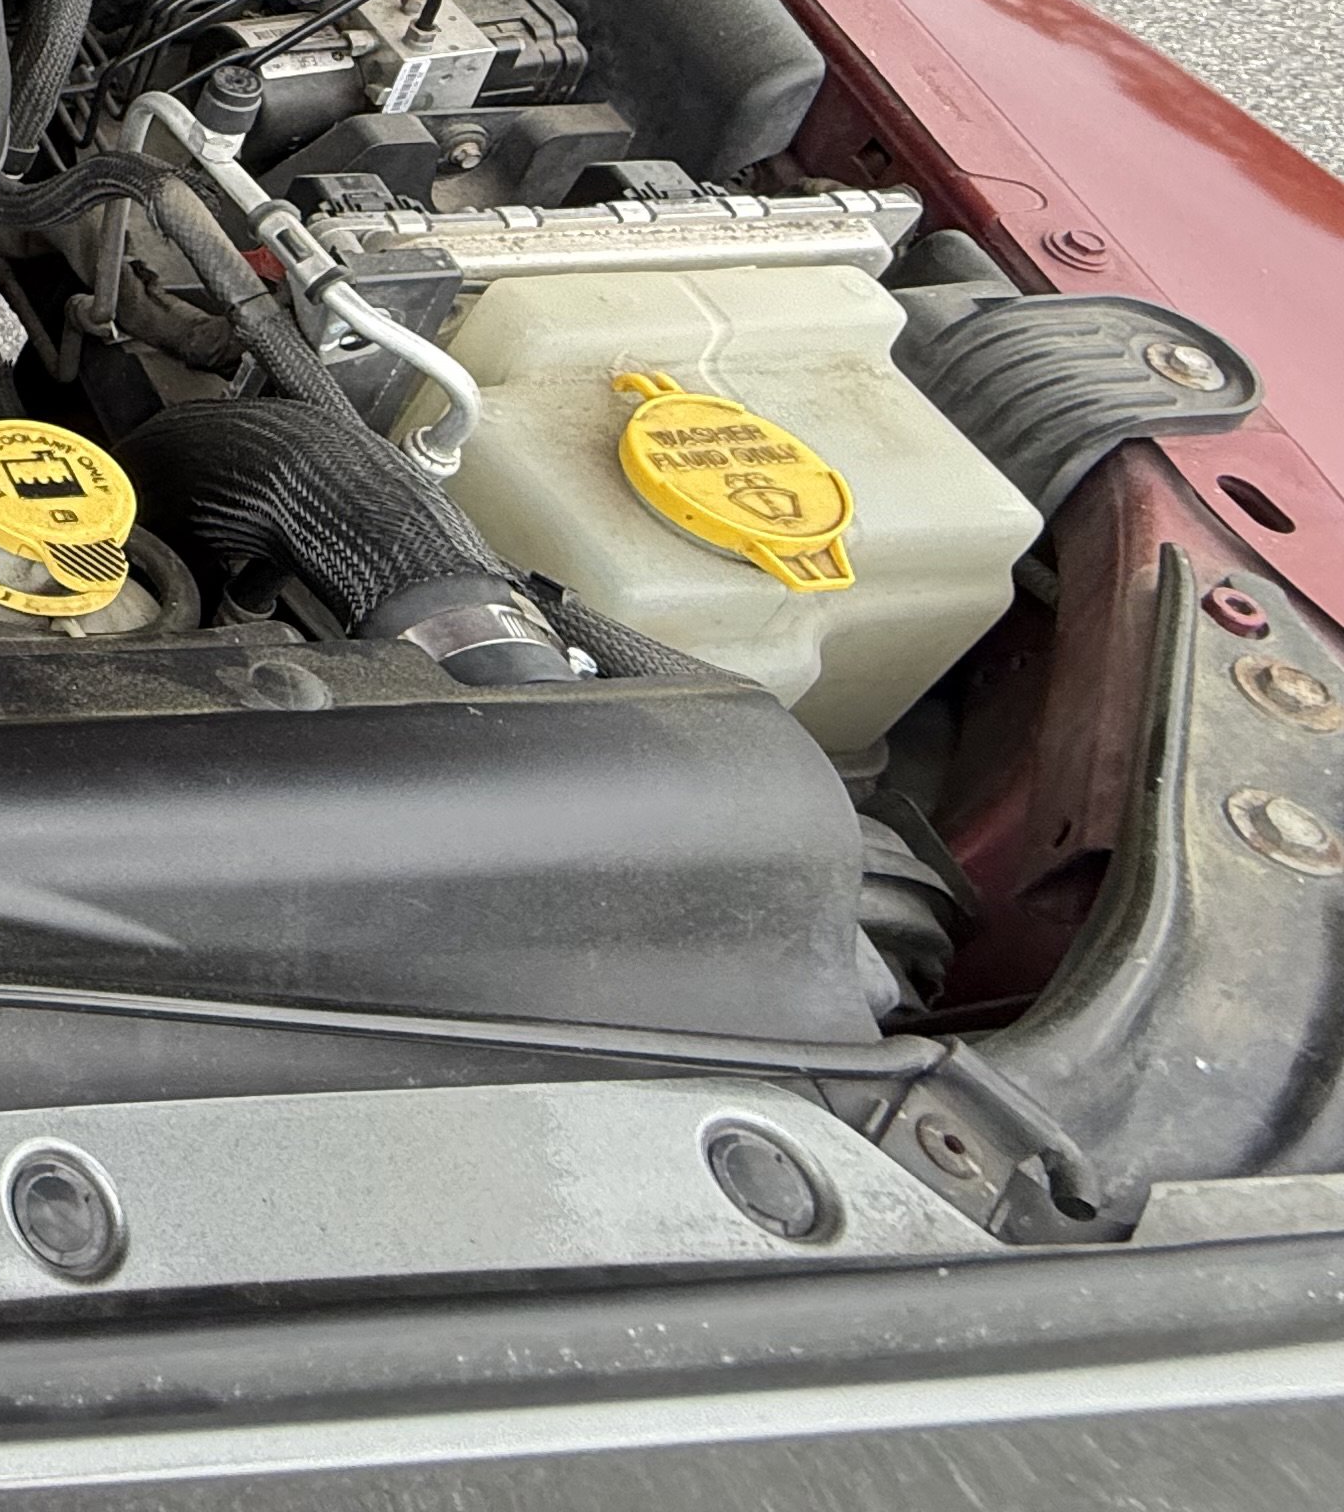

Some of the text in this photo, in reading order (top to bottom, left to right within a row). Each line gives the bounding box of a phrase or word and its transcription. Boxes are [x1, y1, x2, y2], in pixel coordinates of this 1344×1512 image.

[645, 423, 769, 449] WASHER
[647, 442, 801, 473] FLUID ONLY
[77, 455, 112, 495] ONLY
